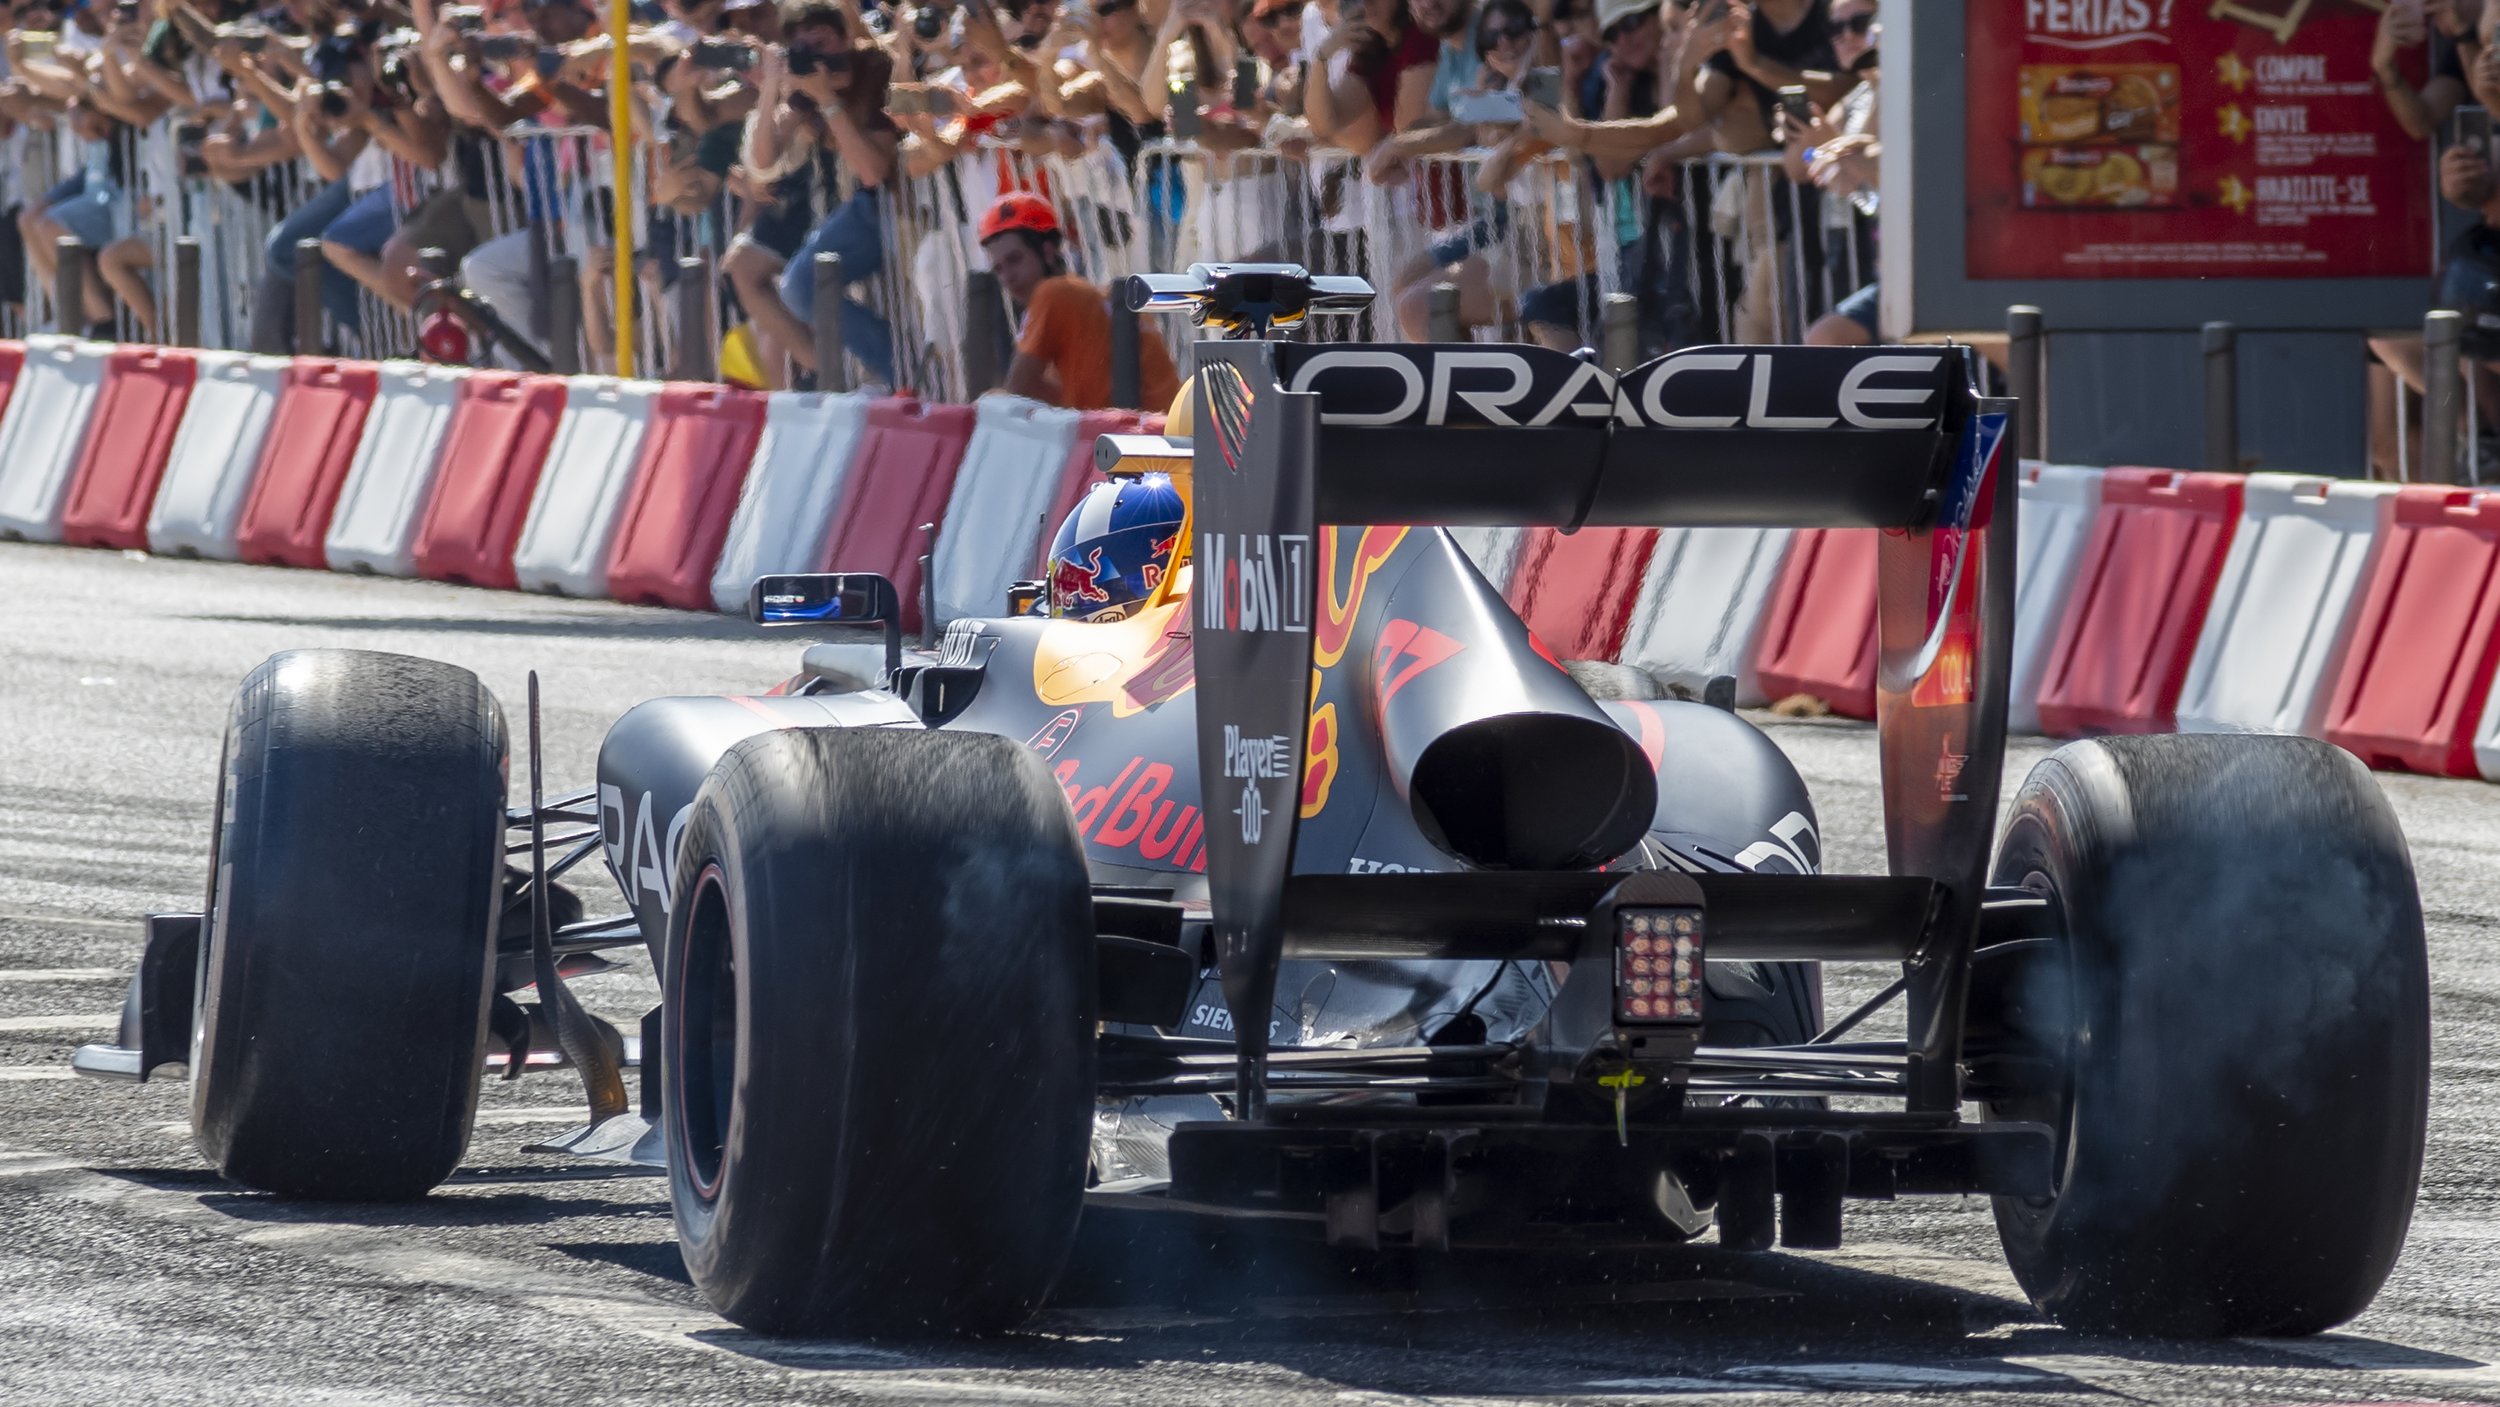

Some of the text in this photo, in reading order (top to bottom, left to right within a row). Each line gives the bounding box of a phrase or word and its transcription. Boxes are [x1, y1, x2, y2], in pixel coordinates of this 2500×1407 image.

[1291, 351, 1941, 429] ORACLE
[1204, 533, 1279, 632] Mobil
[1224, 724, 1275, 792] Player
